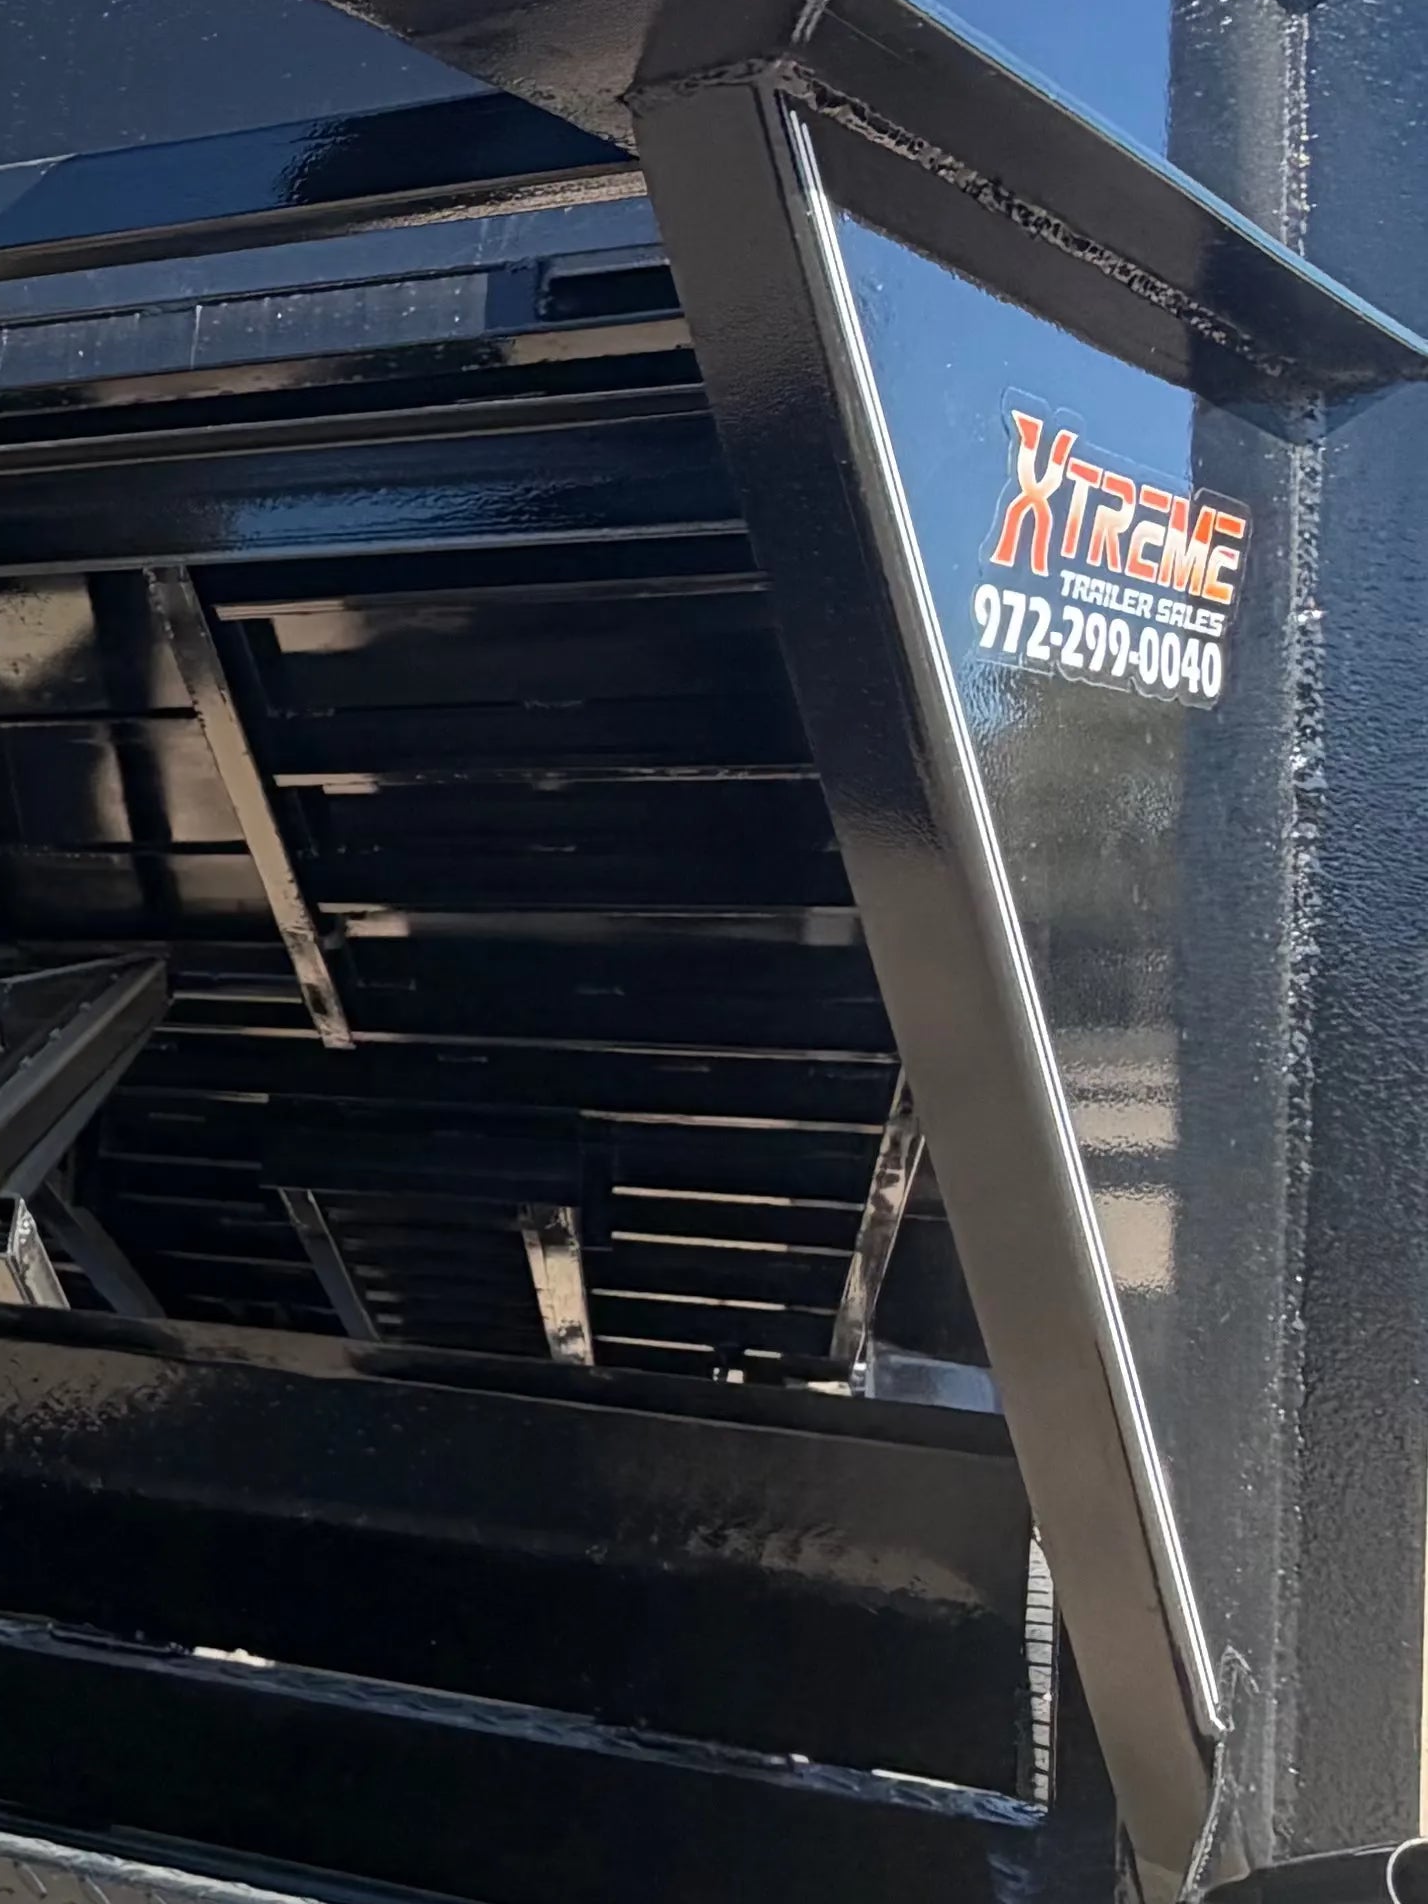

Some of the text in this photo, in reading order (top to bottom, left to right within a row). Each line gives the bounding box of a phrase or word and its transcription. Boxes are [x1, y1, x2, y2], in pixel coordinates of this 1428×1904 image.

[989, 408, 1247, 605] XTREME
[973, 584, 1222, 697] 972-299-0040
[1059, 570, 1225, 637] TRAILER SALES
